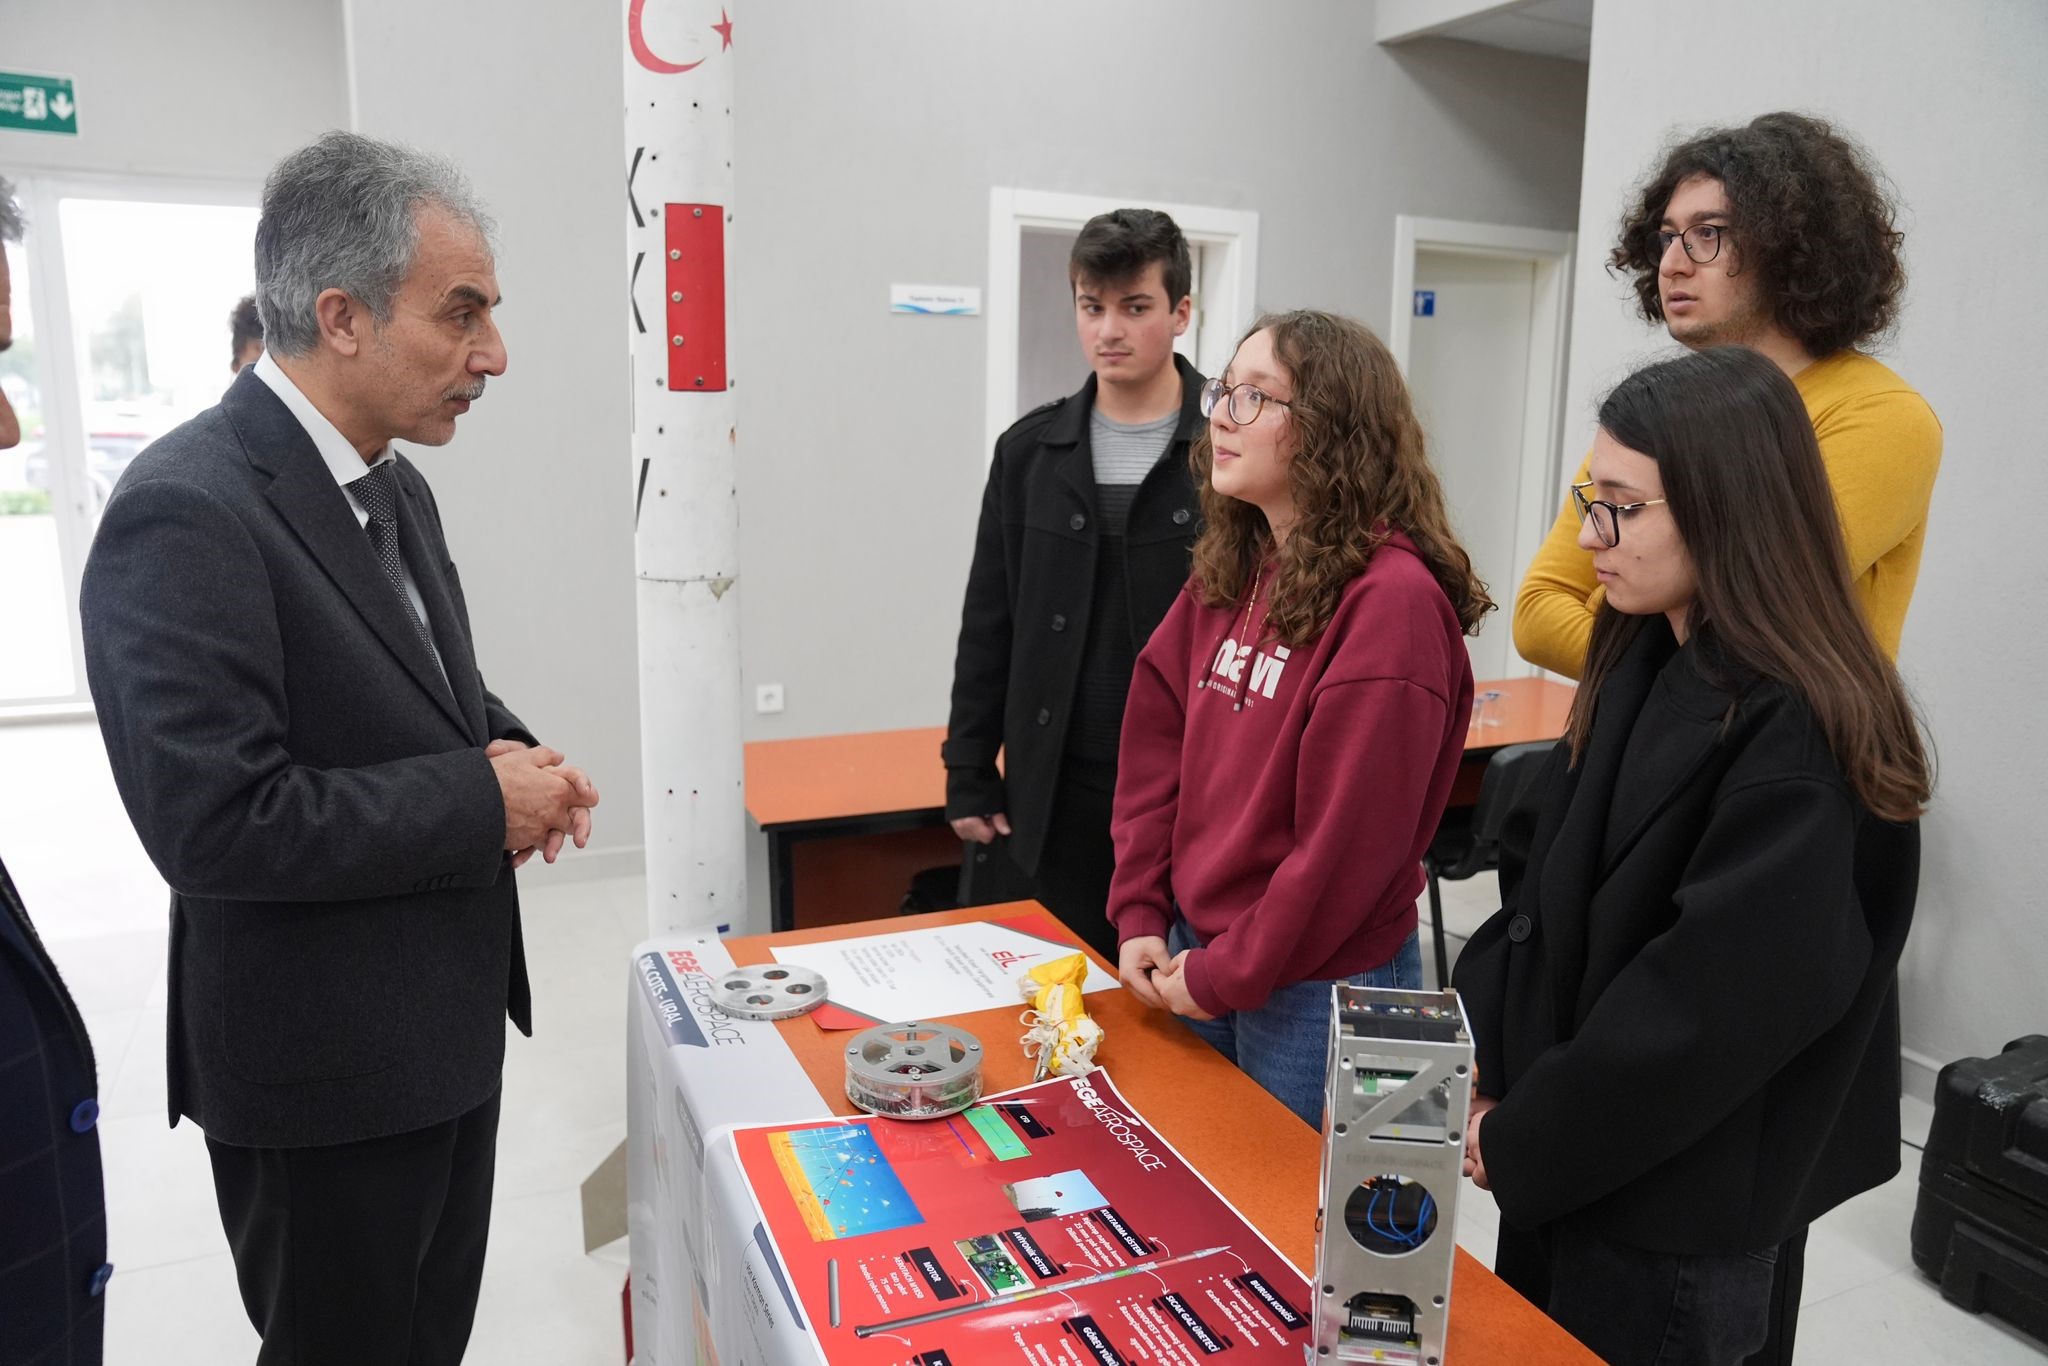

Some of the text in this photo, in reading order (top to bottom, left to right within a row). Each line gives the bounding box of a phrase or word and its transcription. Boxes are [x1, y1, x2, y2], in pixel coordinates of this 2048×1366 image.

[646, 970, 668, 997] COTS
[659, 998, 683, 1028] URAL
[1012, 1231, 1051, 1276] AVİYONİK SİSTEM
[1100, 1208, 1148, 1257] KURTARMA SİSTEMİ
[923, 1261, 942, 1283] MOTOR
[1131, 1302, 1160, 1334] TEKNOFEST
[1223, 1278, 1235, 1290] Von
[1232, 1289, 1254, 1311] Karman
[1252, 1309, 1271, 1328] burun
[1229, 1301, 1259, 1328] Cam elyaf
[1249, 1279, 1297, 1323] BURUN KONİSİ
[1083, 1326, 1104, 1350] GÖREV
[1165, 1294, 1220, 1353] SICAK GAZ ÜRETECİ
[1234, 1320, 1260, 1347] kaplama
